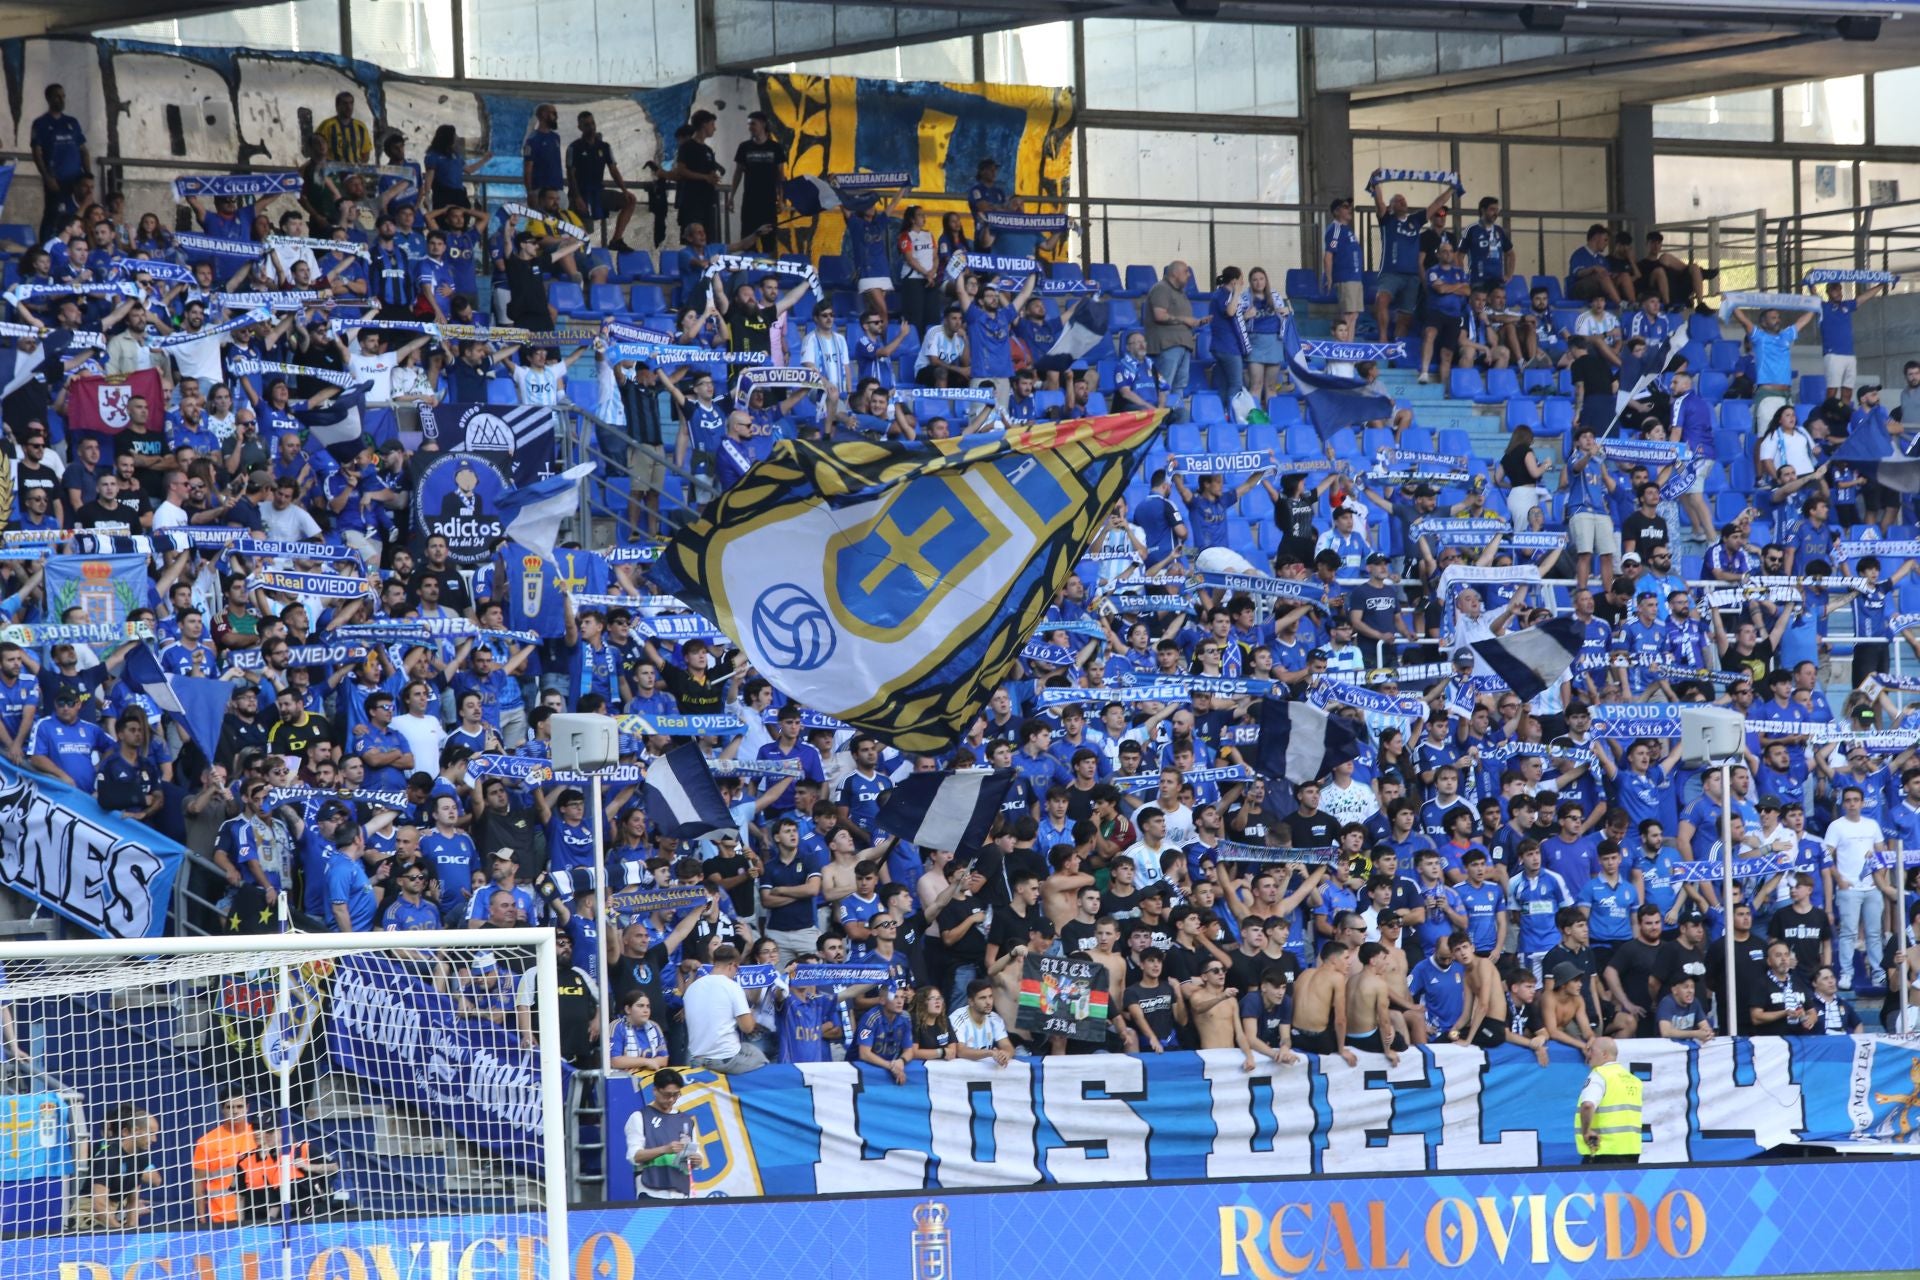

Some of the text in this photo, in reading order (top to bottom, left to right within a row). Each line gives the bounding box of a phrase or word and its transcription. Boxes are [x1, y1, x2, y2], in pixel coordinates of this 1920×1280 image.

[968, 255, 1036, 271] REAL OVIEDO
[769, 370, 807, 382] OVIEDO
[923, 388, 941, 398] EN
[943, 388, 993, 399] TERCERA
[459, 405, 480, 428] OVIEDO
[1187, 453, 1261, 471] Real OVIEDO
[433, 517, 502, 538] adictos
[253, 539, 335, 557] Real OVIEDO
[605, 548, 652, 560] VIEDO
[276, 574, 357, 595] Real OVIEDO
[1225, 576, 1302, 596] Real OVIEDO
[1119, 595, 1148, 608] Real
[654, 619, 699, 632] NO HAY
[1606, 705, 1660, 719] PROUD
[656, 715, 688, 728] Real
[1628, 725, 1663, 736] CICLO
[437, 855, 470, 865] DIGI
[733, 973, 767, 986] ICLO
[558, 986, 584, 997] IGI
[1858, 1040, 1872, 1070] LEA
[1853, 1073, 1867, 1107] MUY
[795, 1053, 1152, 1194] LOS
[1196, 1044, 1541, 1179] DEL
[1220, 1188, 1707, 1280] REAL OVIEDO
